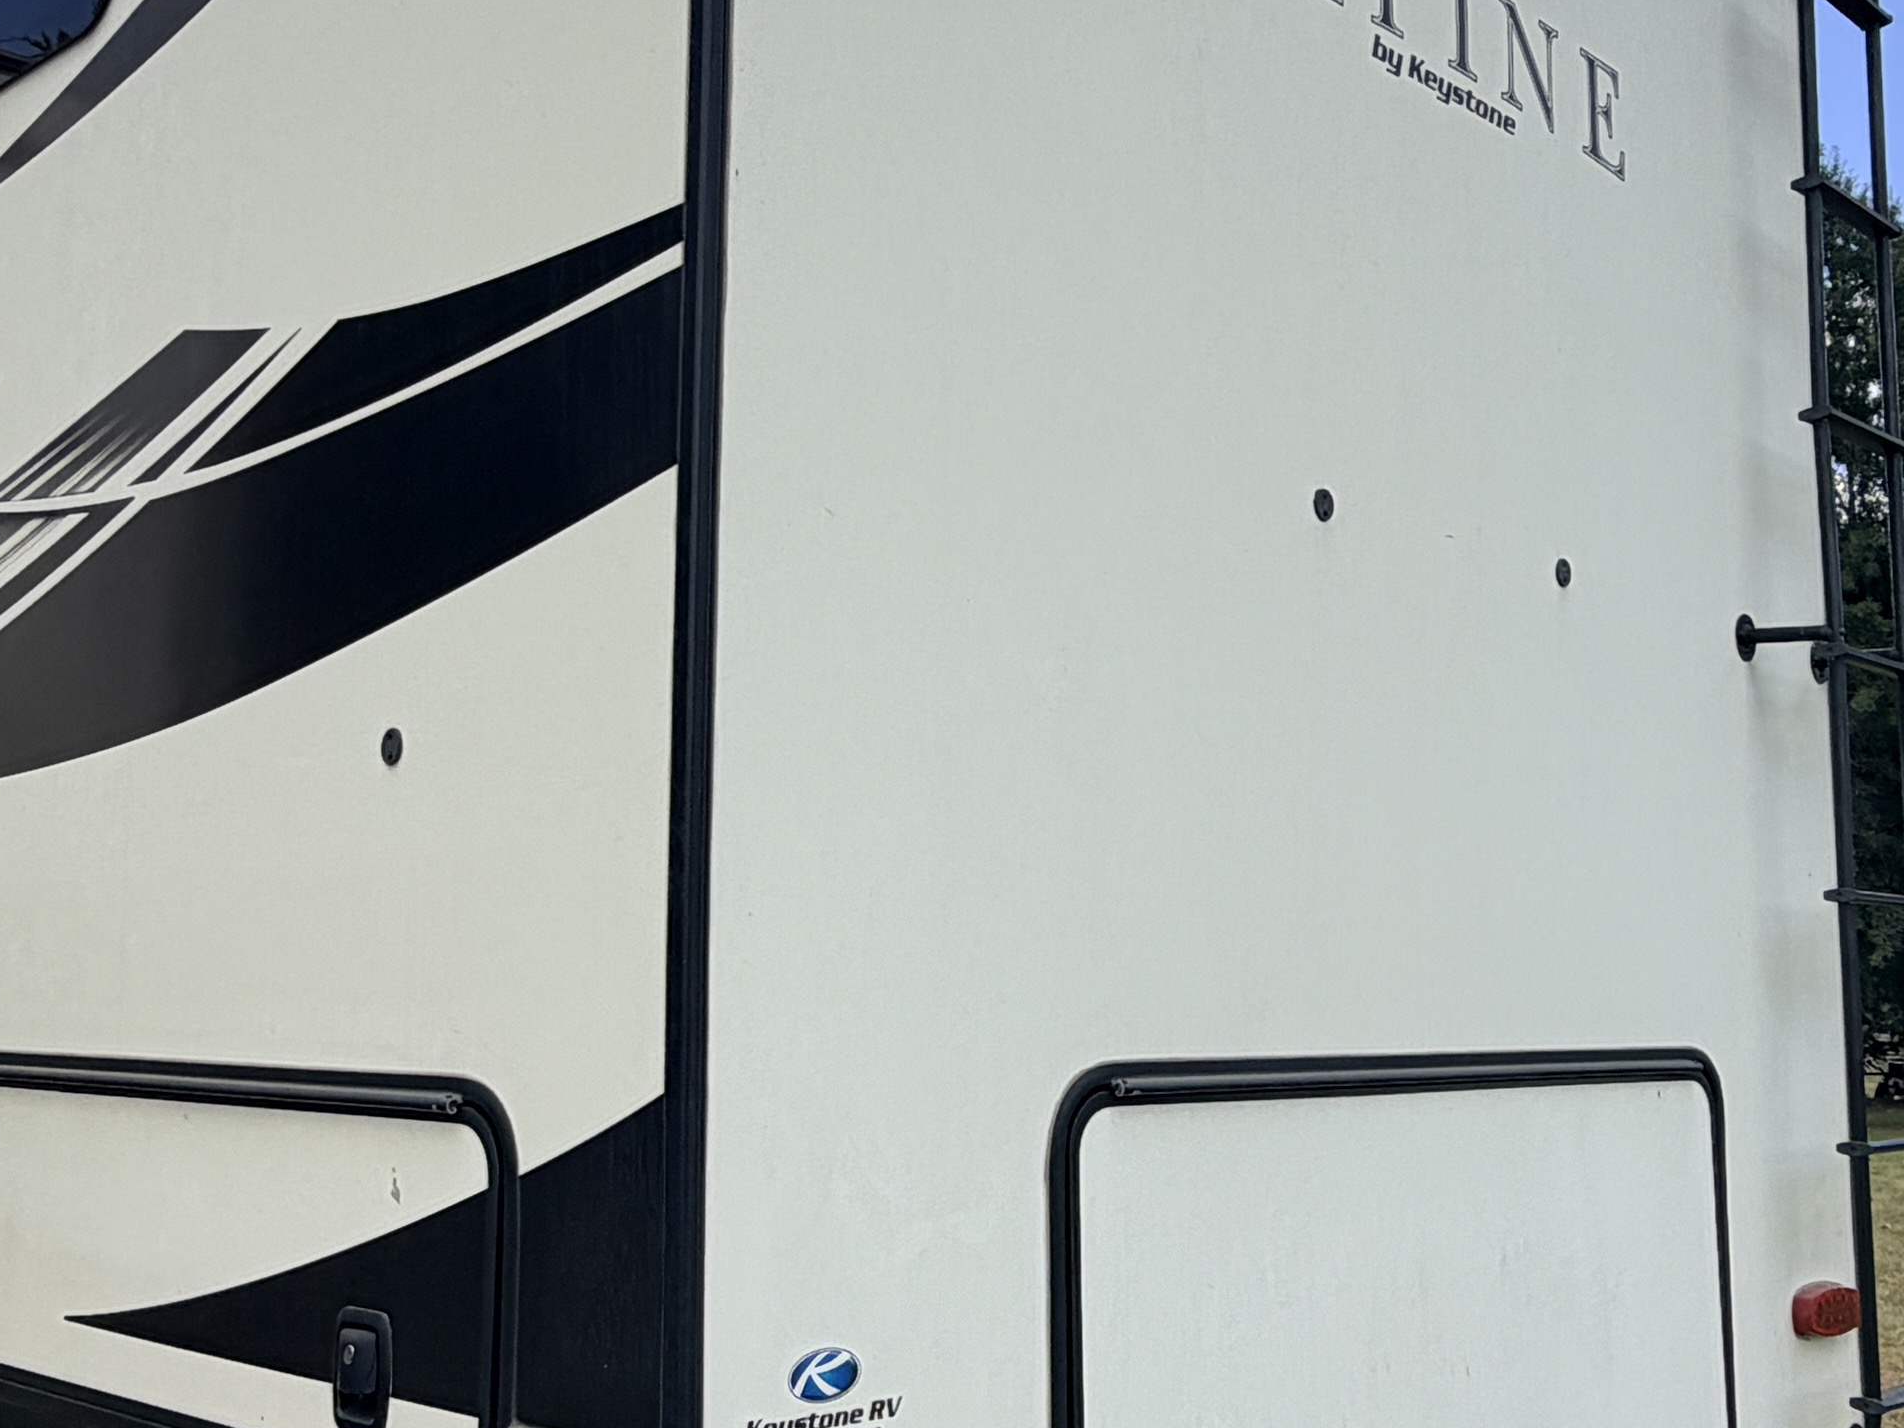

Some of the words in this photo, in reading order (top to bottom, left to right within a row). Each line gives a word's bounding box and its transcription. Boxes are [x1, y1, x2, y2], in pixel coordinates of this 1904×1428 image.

[1371, 33, 1404, 78] by
[1407, 53, 1517, 136] Keystone
[868, 1395, 903, 1421] RV
